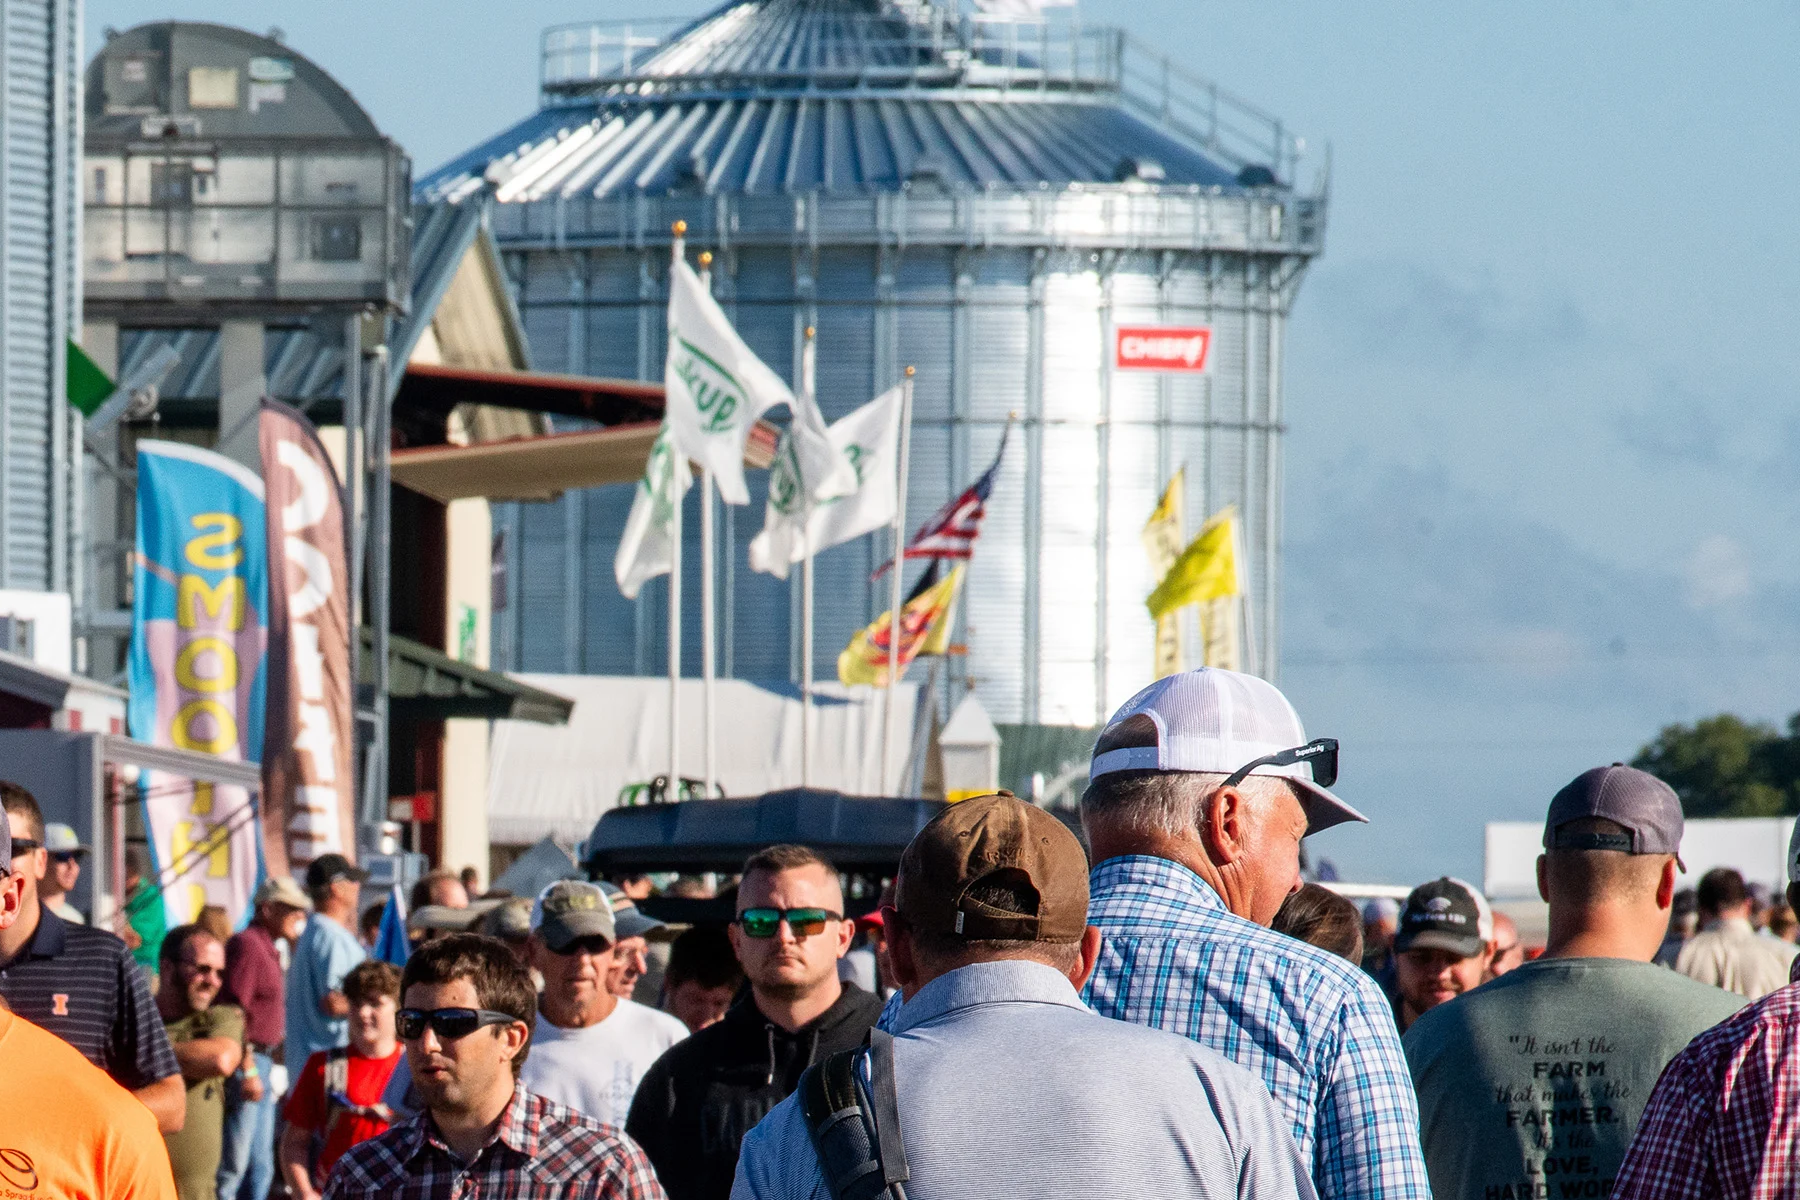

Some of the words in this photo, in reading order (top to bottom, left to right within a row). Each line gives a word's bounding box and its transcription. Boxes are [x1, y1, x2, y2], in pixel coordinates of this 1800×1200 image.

[1295, 746, 1317, 757] Superior
[1588, 1035, 1616, 1054] the
[1533, 1060, 1605, 1078] FARM
[1496, 1084, 1534, 1104] that
[1542, 1081, 1596, 1101] makes
[1603, 1080, 1632, 1099] the
[1506, 1106, 1619, 1128] FARMER.
[1526, 1156, 1599, 1176] LOVE,
